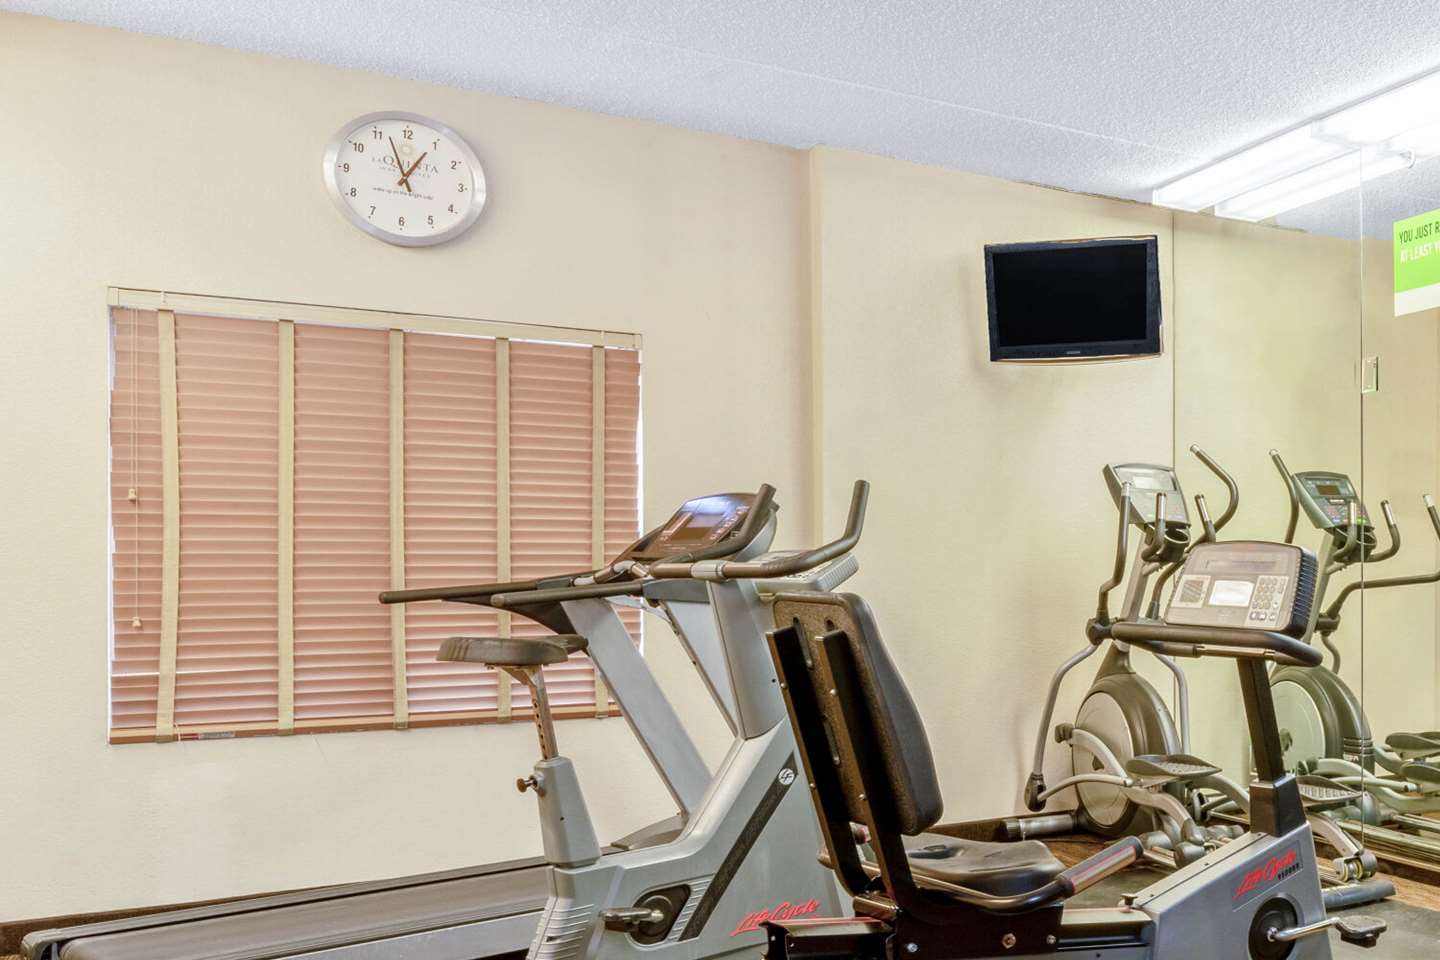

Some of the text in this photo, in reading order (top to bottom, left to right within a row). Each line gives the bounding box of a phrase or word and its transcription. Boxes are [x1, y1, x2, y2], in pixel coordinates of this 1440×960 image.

[372, 130, 383, 140] 11
[402, 130, 413, 140] 12
[353, 142, 364, 153] 10
[432, 141, 438, 150] 1
[343, 164, 350, 172] 9
[451, 160, 457, 170] 2
[350, 187, 357, 197] 8
[457, 183, 464, 192] 3
[370, 205, 376, 215] 7
[447, 204, 454, 213] 4
[398, 217, 405, 226] 6
[427, 215, 434, 225] 5
[1399, 230, 1413, 244] YOU
[1415, 223, 1432, 239] JUST
[1400, 248, 1408, 262] AT
[1410, 242, 1432, 261] LEAST
